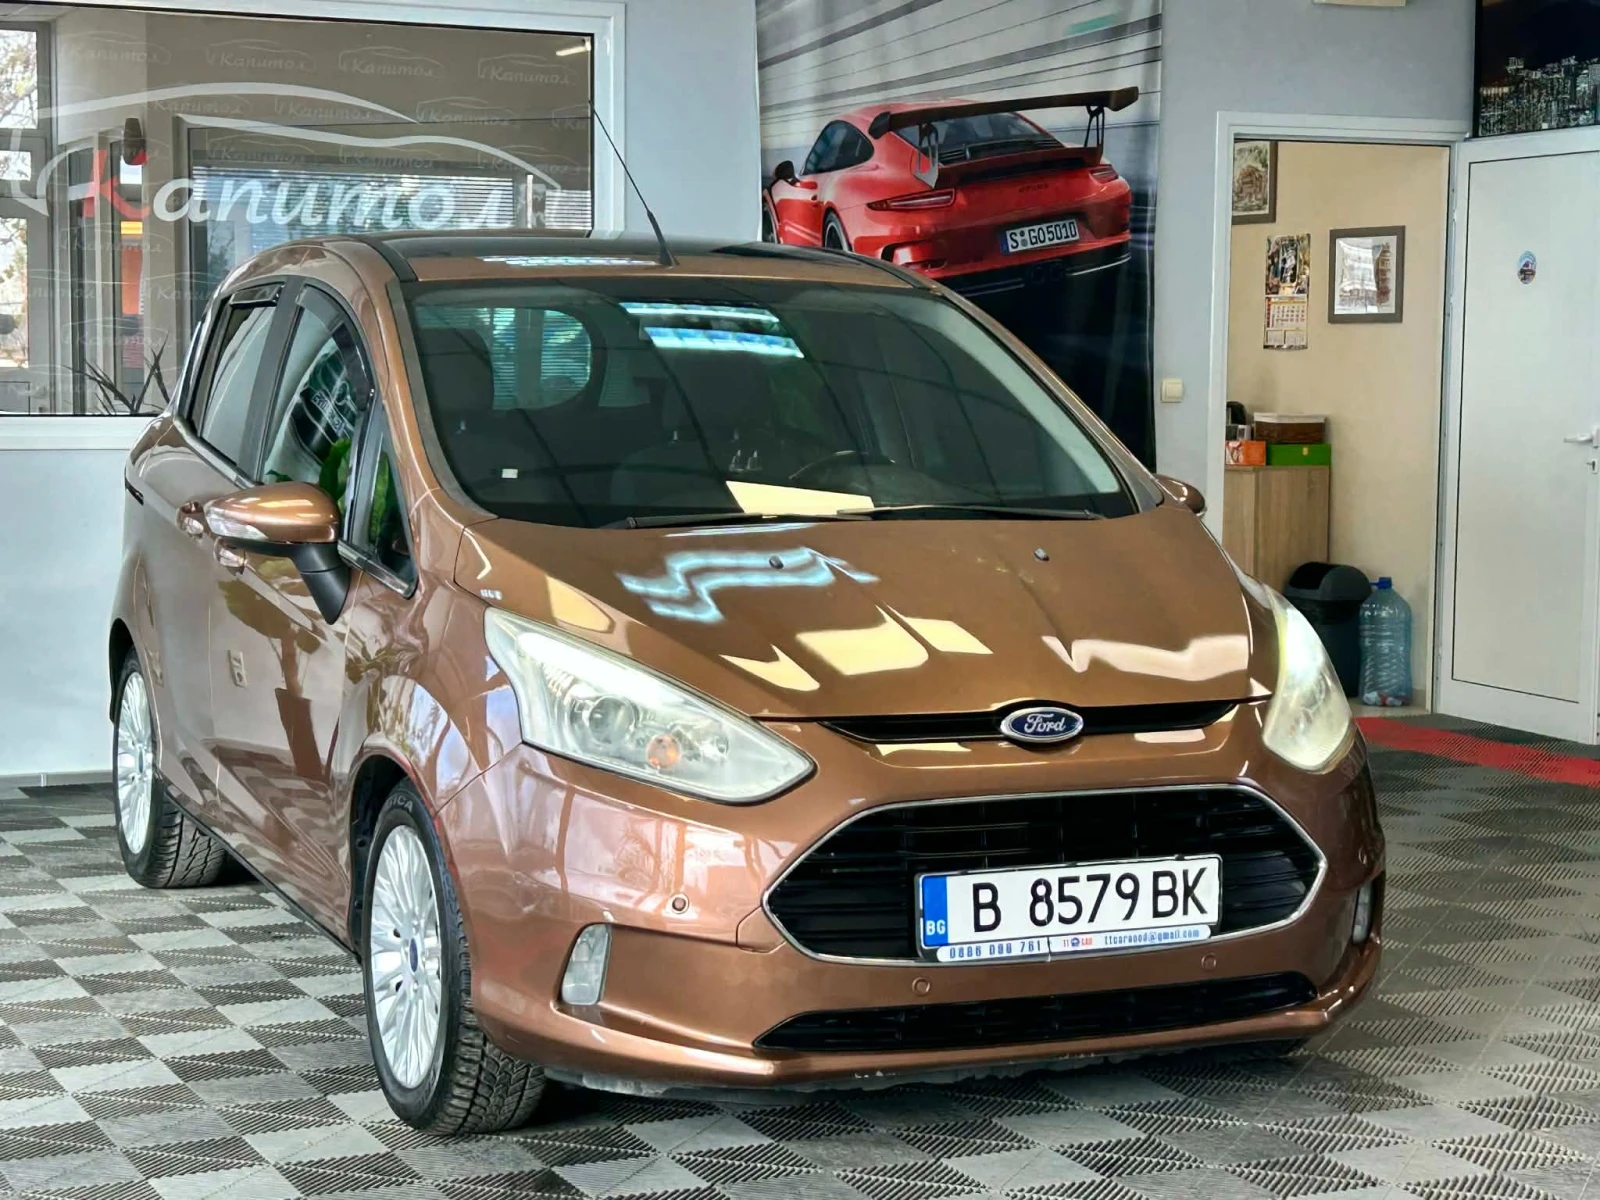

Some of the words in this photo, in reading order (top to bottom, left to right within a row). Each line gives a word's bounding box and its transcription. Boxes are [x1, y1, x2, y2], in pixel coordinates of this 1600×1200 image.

[1023, 713, 1066, 733] Ford
[972, 882, 1002, 933] B
[1029, 872, 1141, 927] 8579
[1151, 867, 1209, 919] BK
[925, 919, 946, 936] BG
